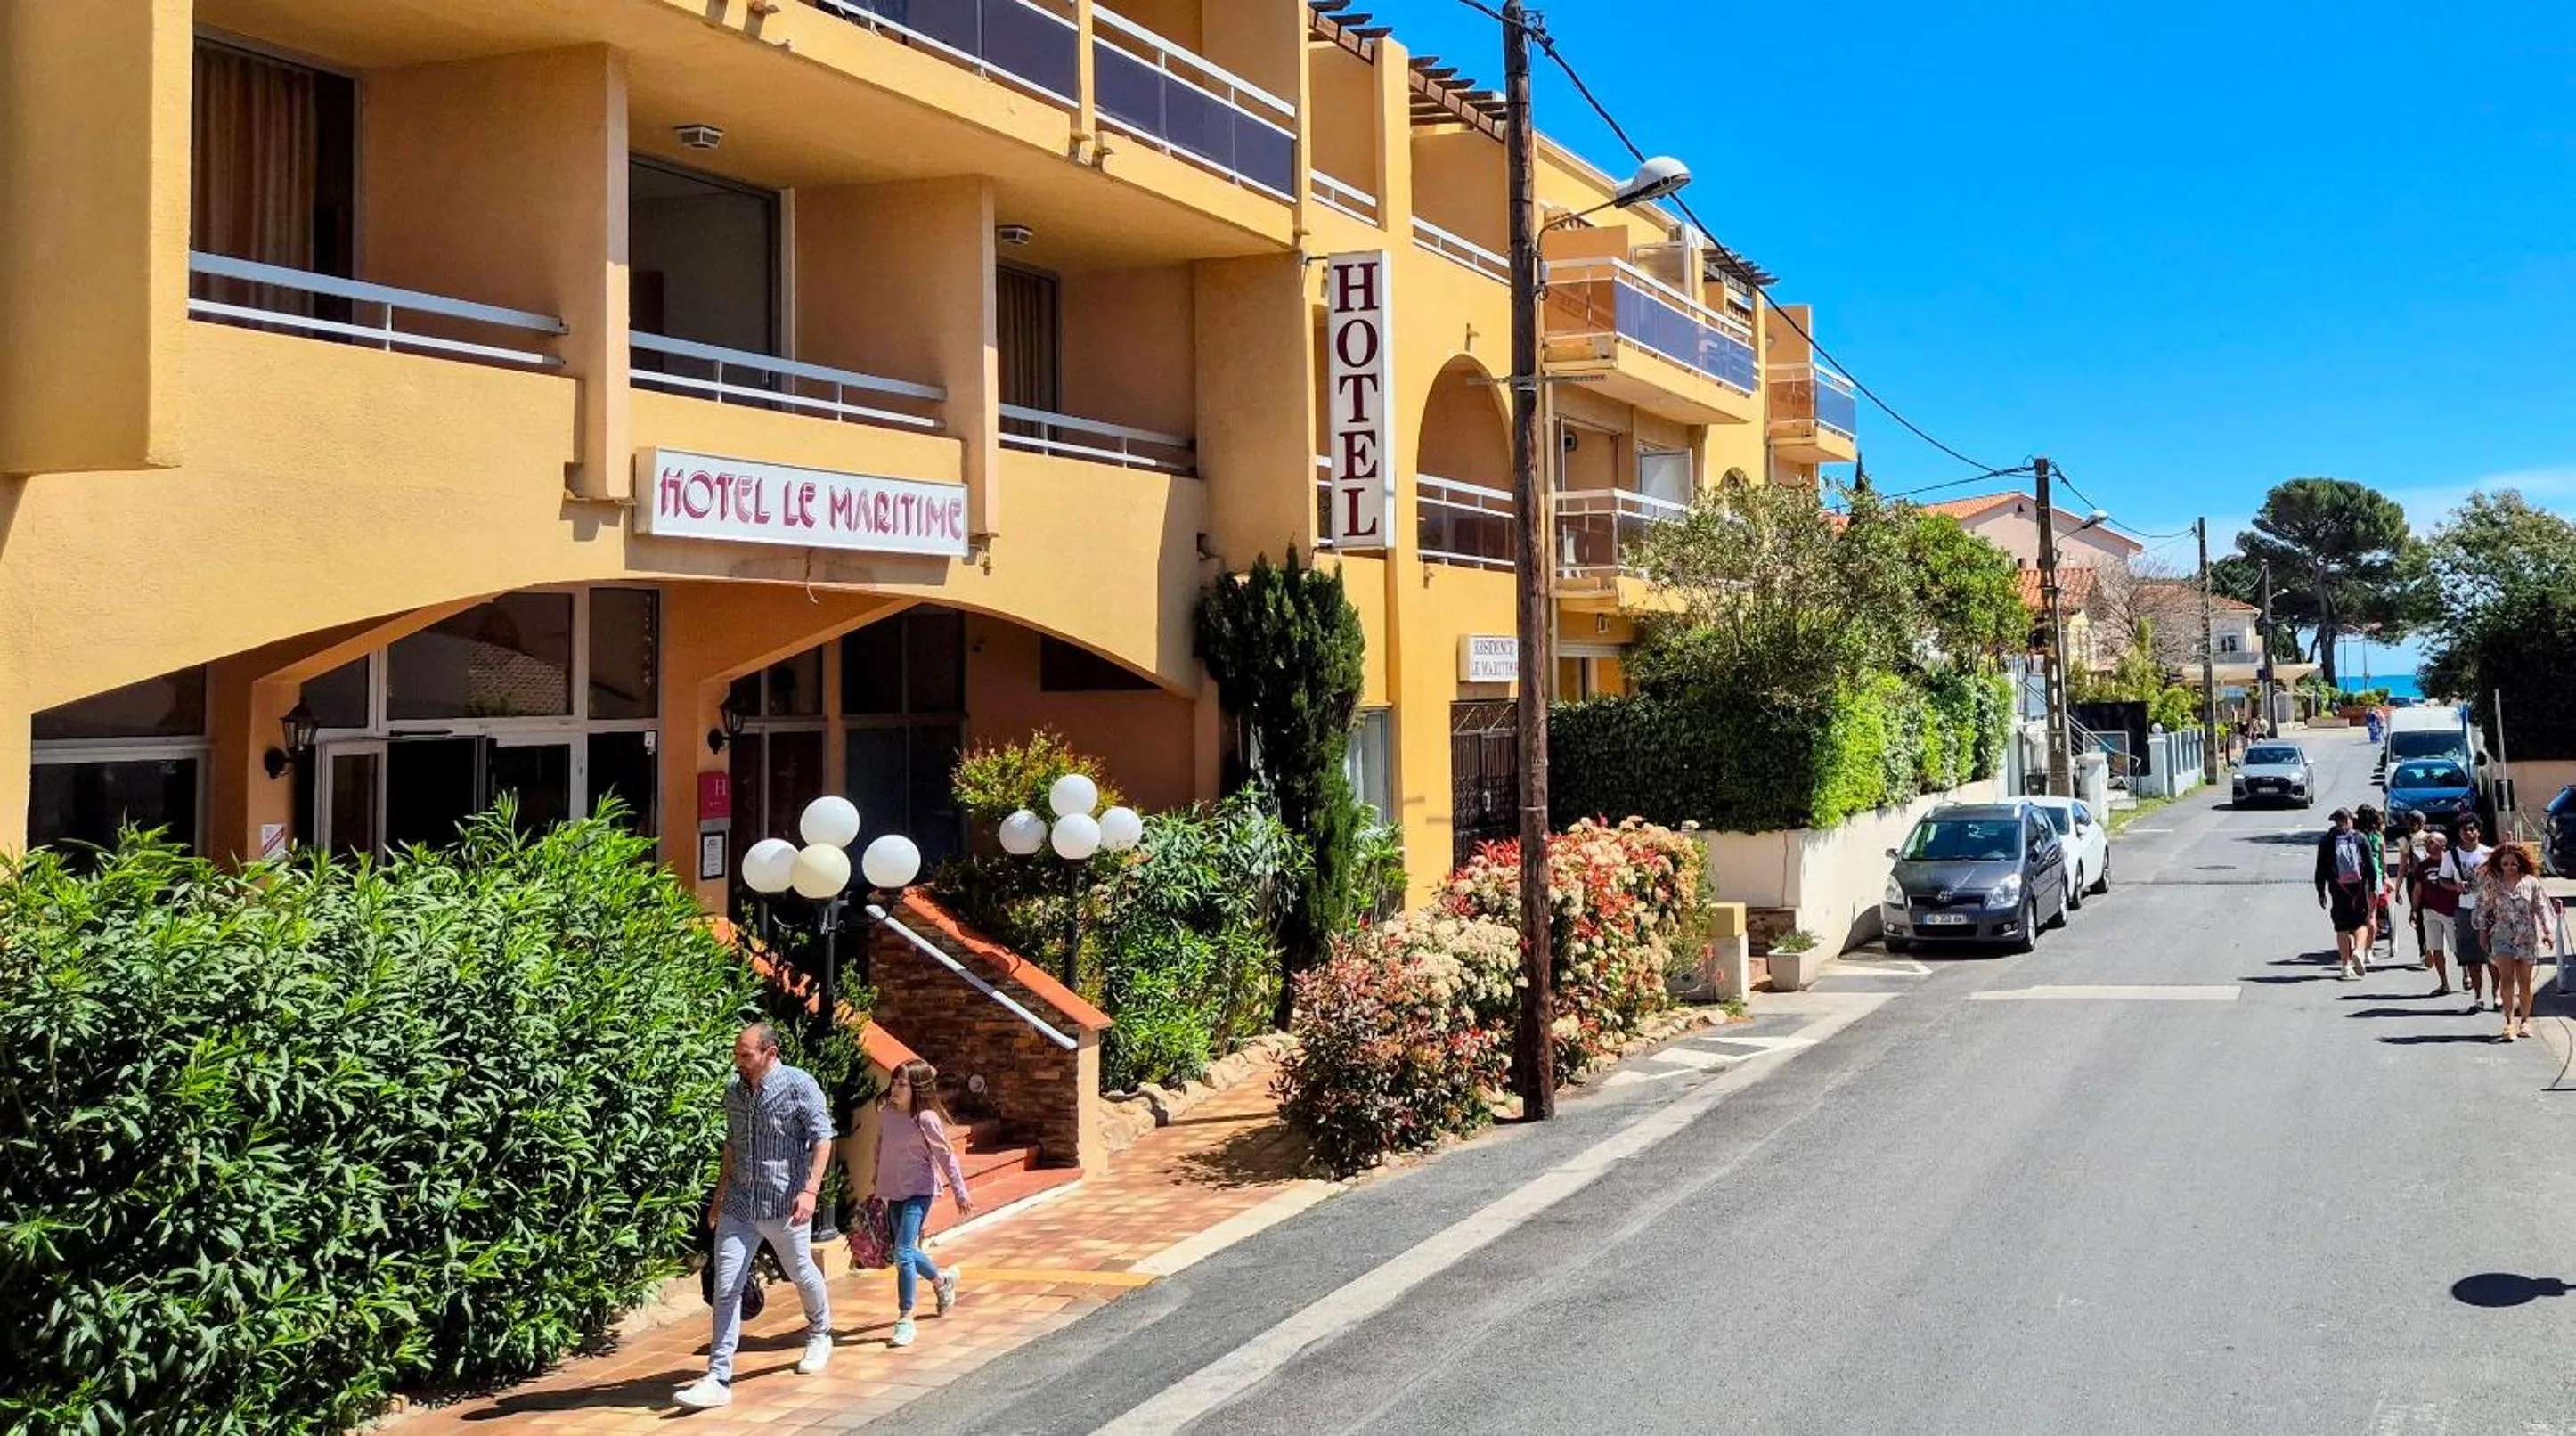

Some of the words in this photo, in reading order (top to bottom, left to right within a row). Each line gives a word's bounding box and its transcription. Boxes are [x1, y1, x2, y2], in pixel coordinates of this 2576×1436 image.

[1333, 261, 1380, 536] HOTEL
[660, 467, 770, 524] HOTEL
[784, 481, 817, 528] LE
[829, 485, 962, 540] MARITIME
